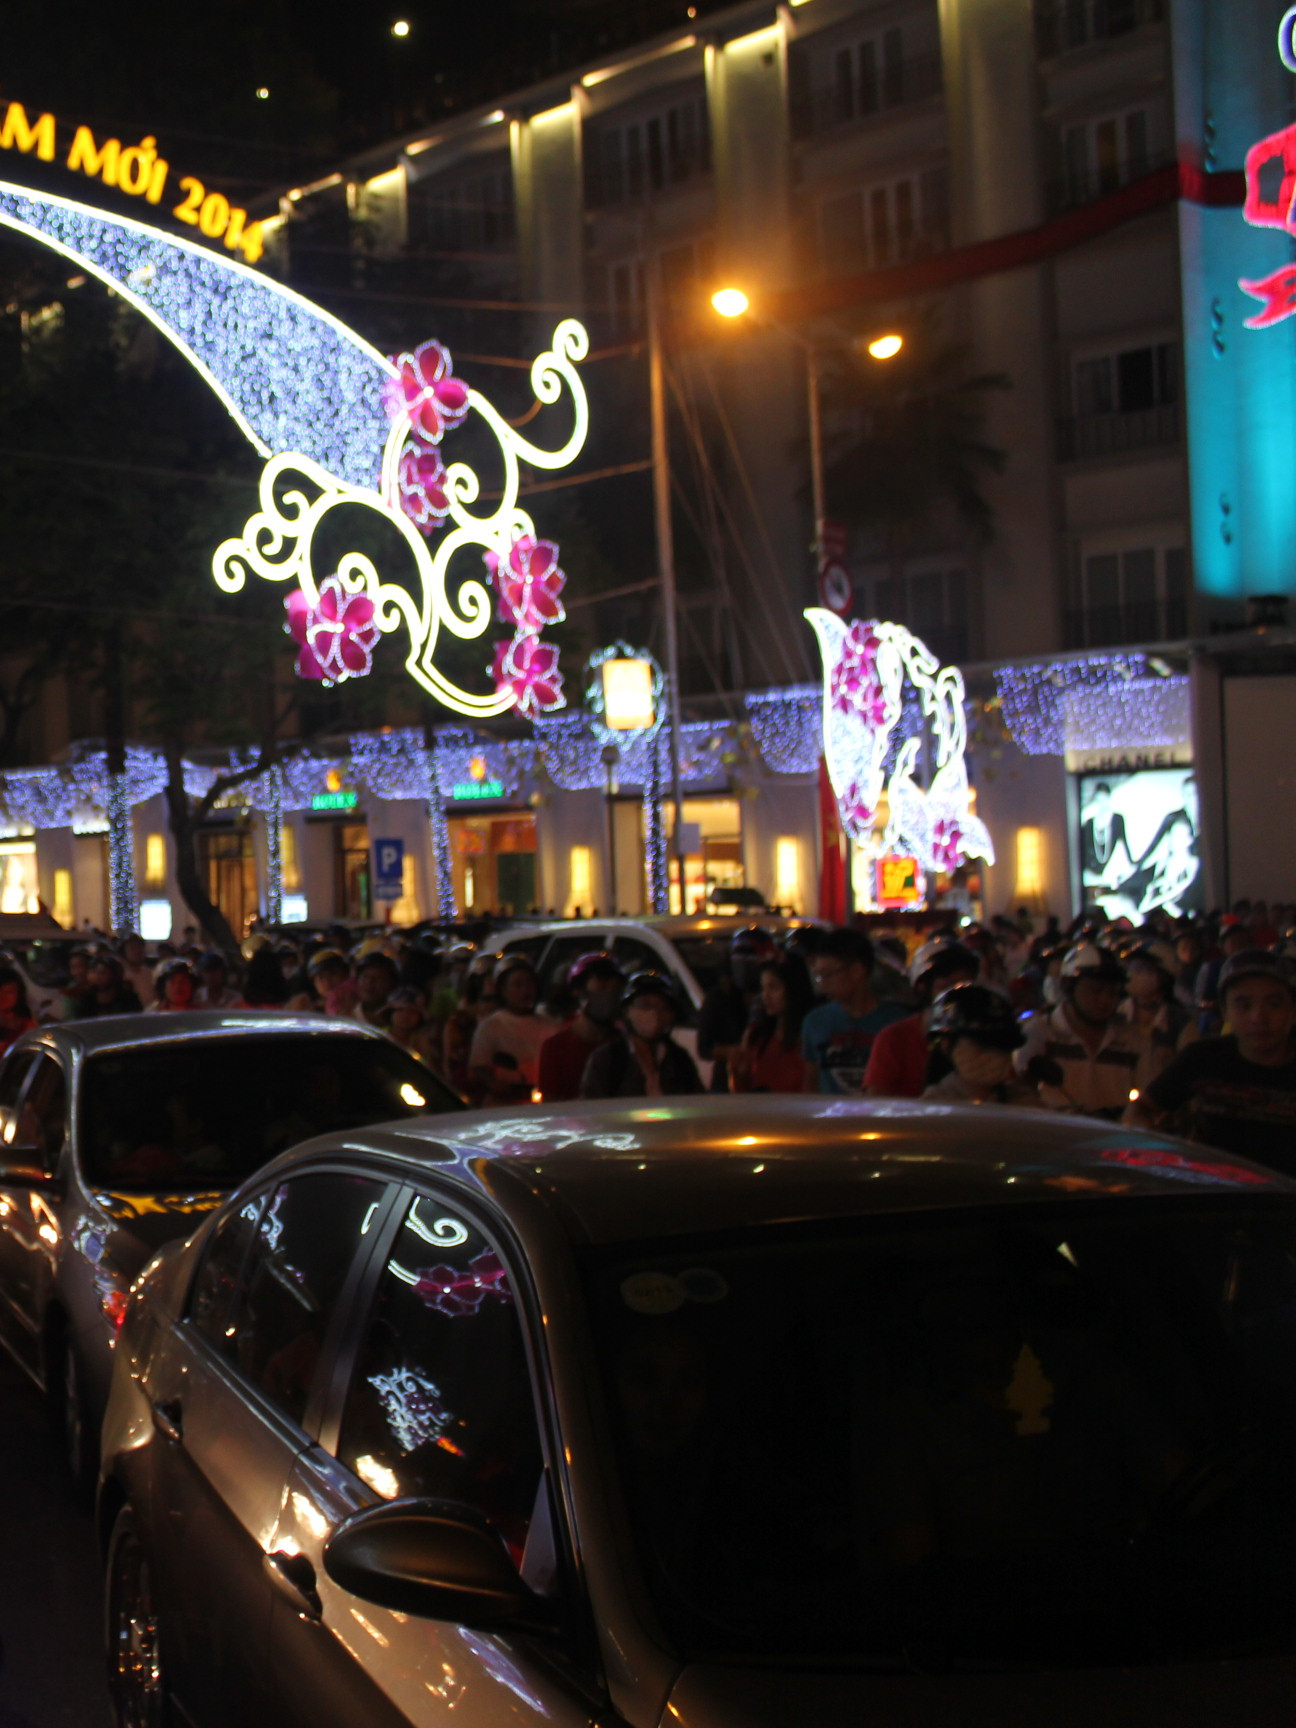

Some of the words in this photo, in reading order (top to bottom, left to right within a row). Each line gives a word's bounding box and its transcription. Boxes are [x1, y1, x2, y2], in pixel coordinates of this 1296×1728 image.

[67, 125, 169, 205] MỚI
[173, 176, 264, 263] 2014
[1084, 750, 1181, 773] CHANEL
[381, 845, 398, 873] P
